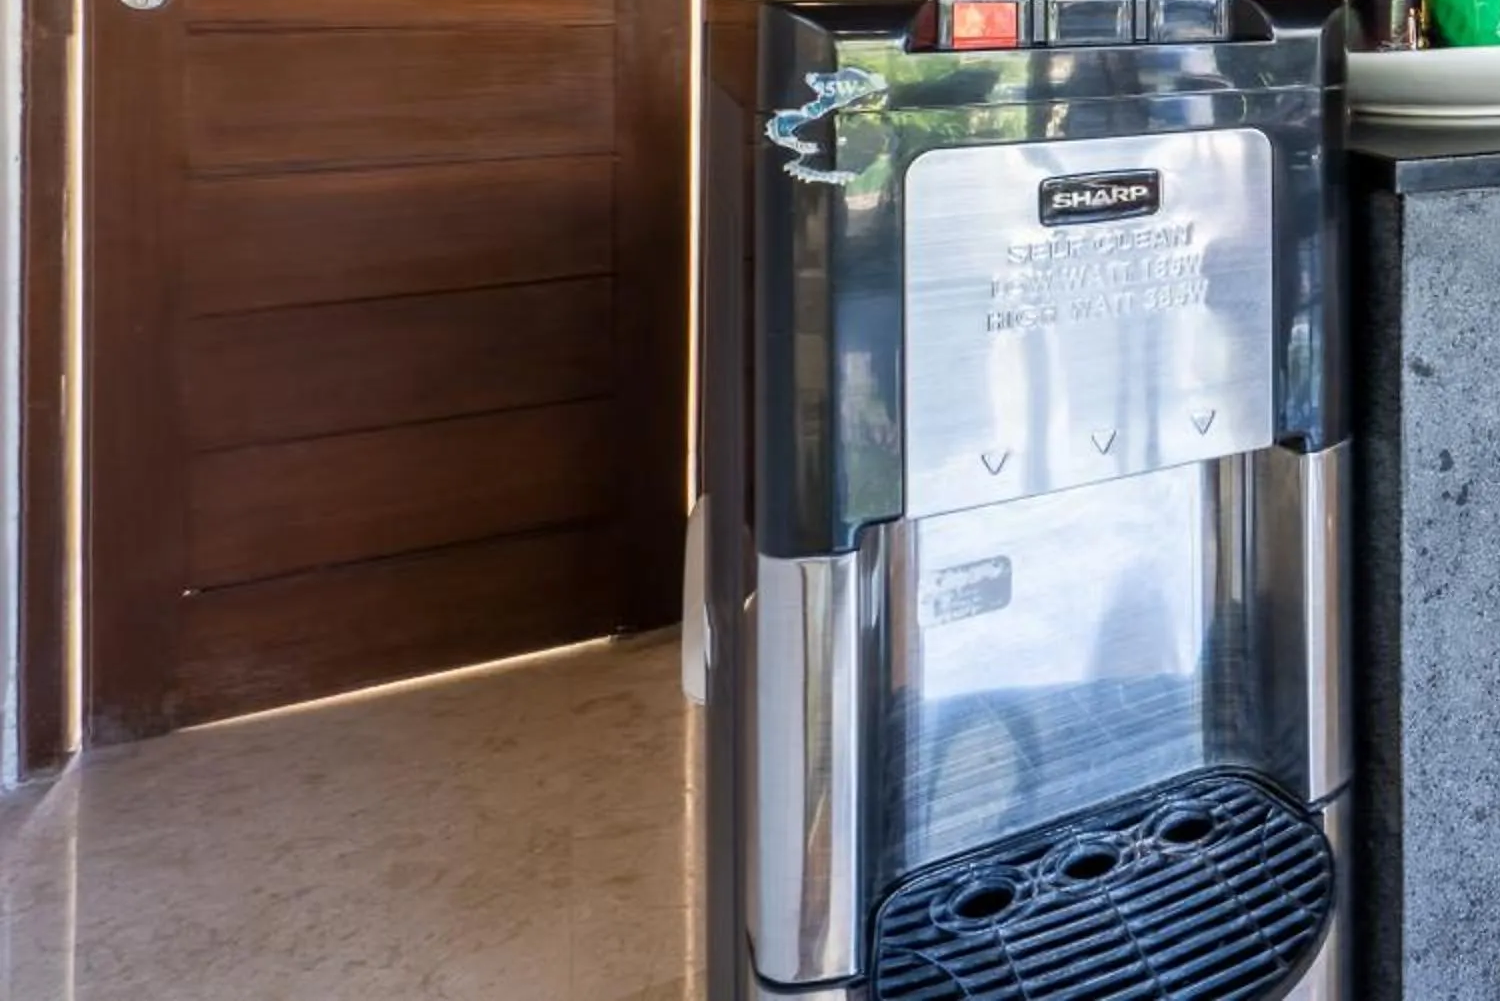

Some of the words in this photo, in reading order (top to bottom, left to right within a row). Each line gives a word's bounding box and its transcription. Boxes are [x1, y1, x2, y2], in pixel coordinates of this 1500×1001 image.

[1052, 185, 1149, 208] SHARP
[1093, 221, 1195, 253] CLEAN
[1062, 257, 1132, 291] WATT
[1070, 290, 1134, 322] WATT
